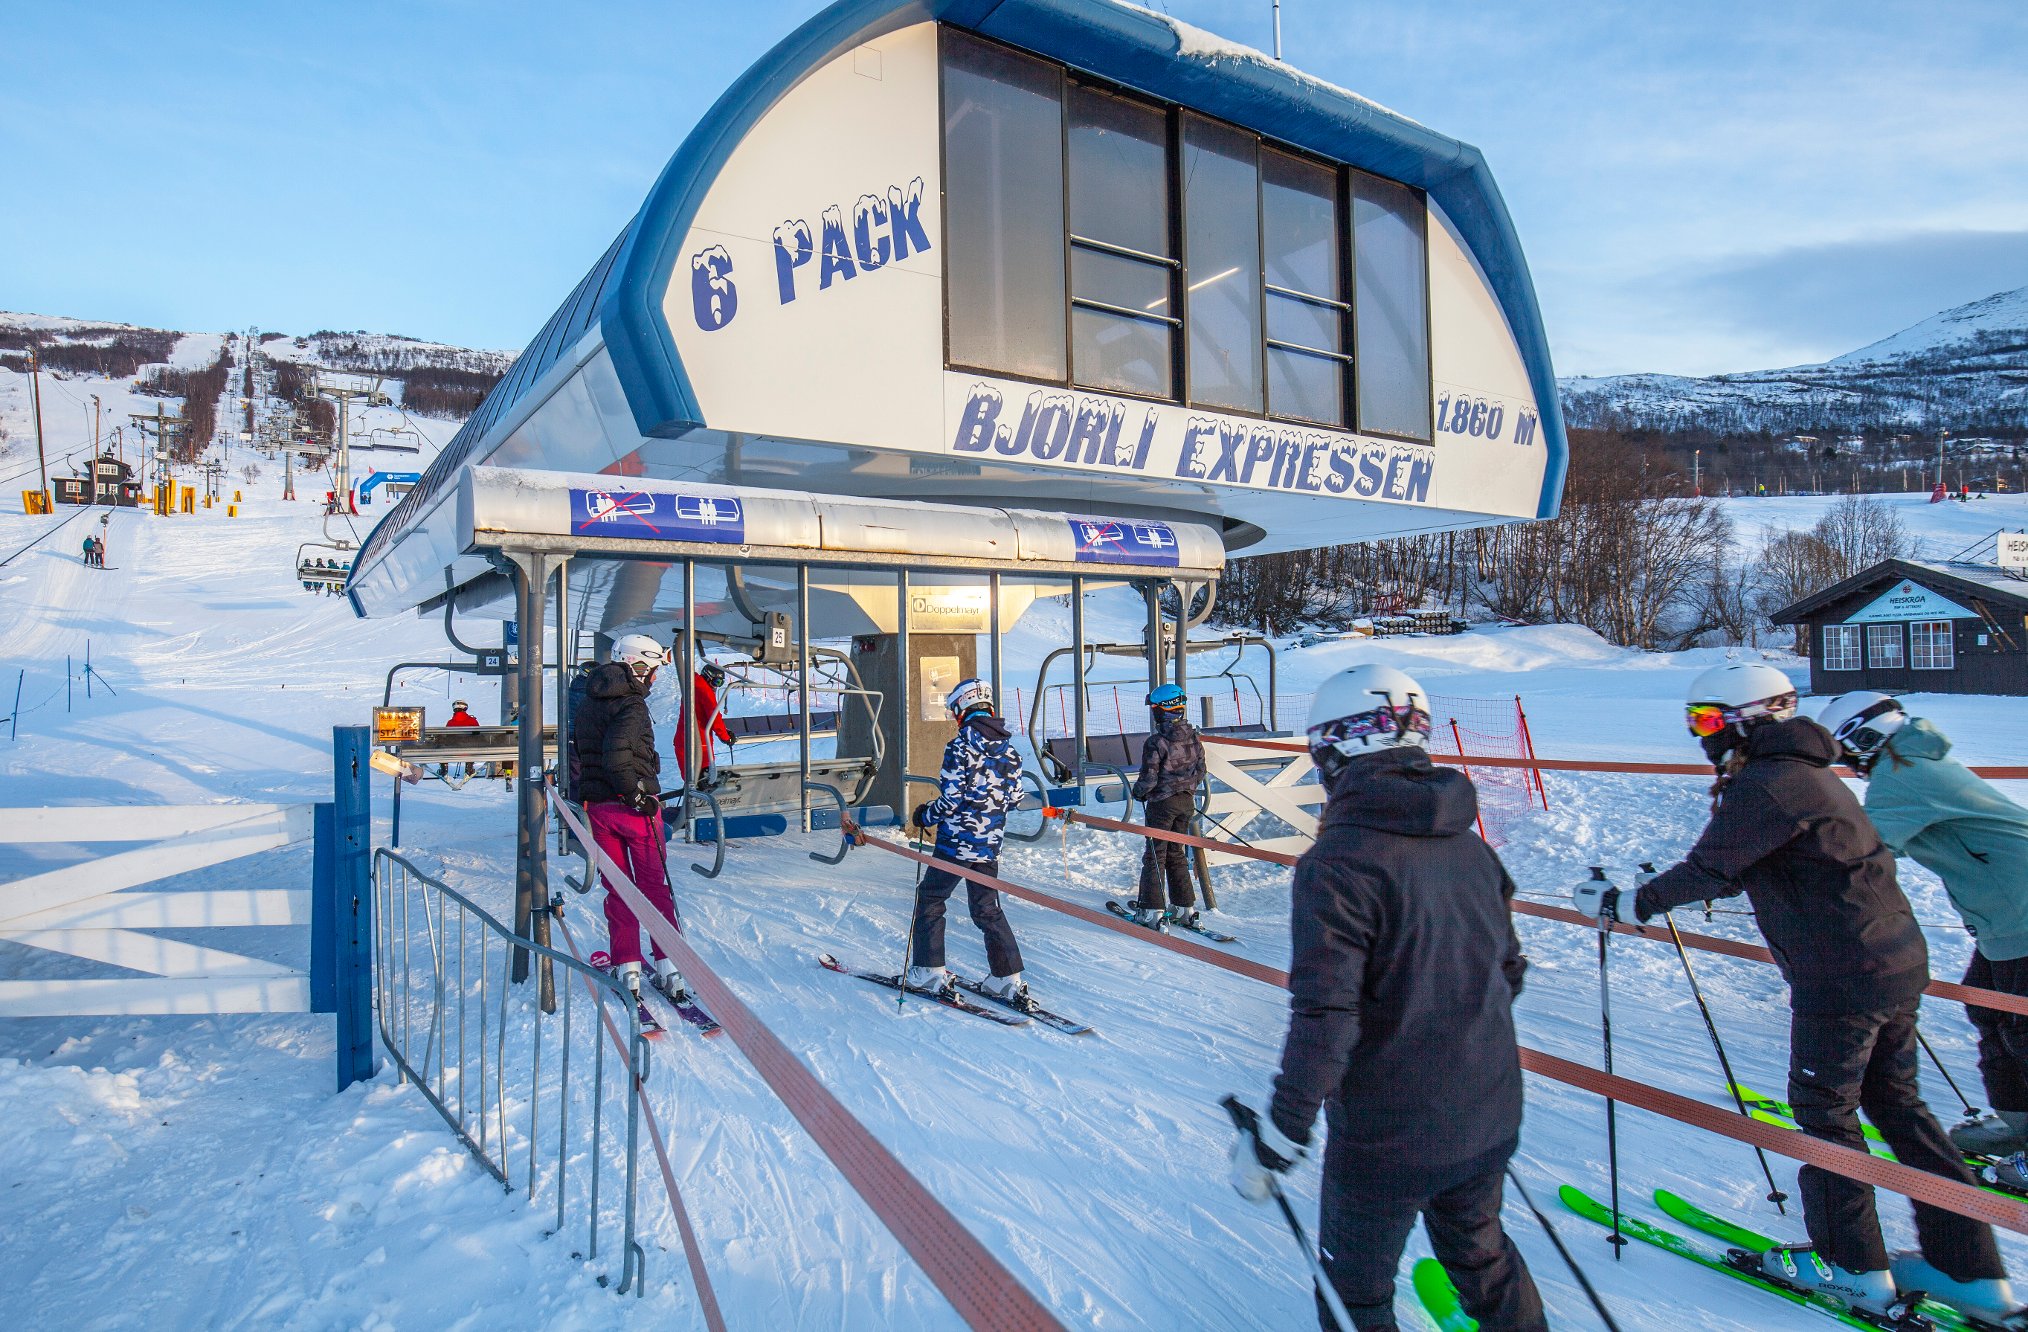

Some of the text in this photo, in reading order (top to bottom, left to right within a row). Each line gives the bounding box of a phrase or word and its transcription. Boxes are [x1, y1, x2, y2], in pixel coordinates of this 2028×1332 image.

[692, 176, 931, 331] 6 PACK
[953, 382, 1435, 502] BJORLI EXPRESSEN
[1437, 390, 1538, 446] 1.860 M
[1890, 596, 1926, 604] HEISKROA
[775, 631, 783, 644] 25
